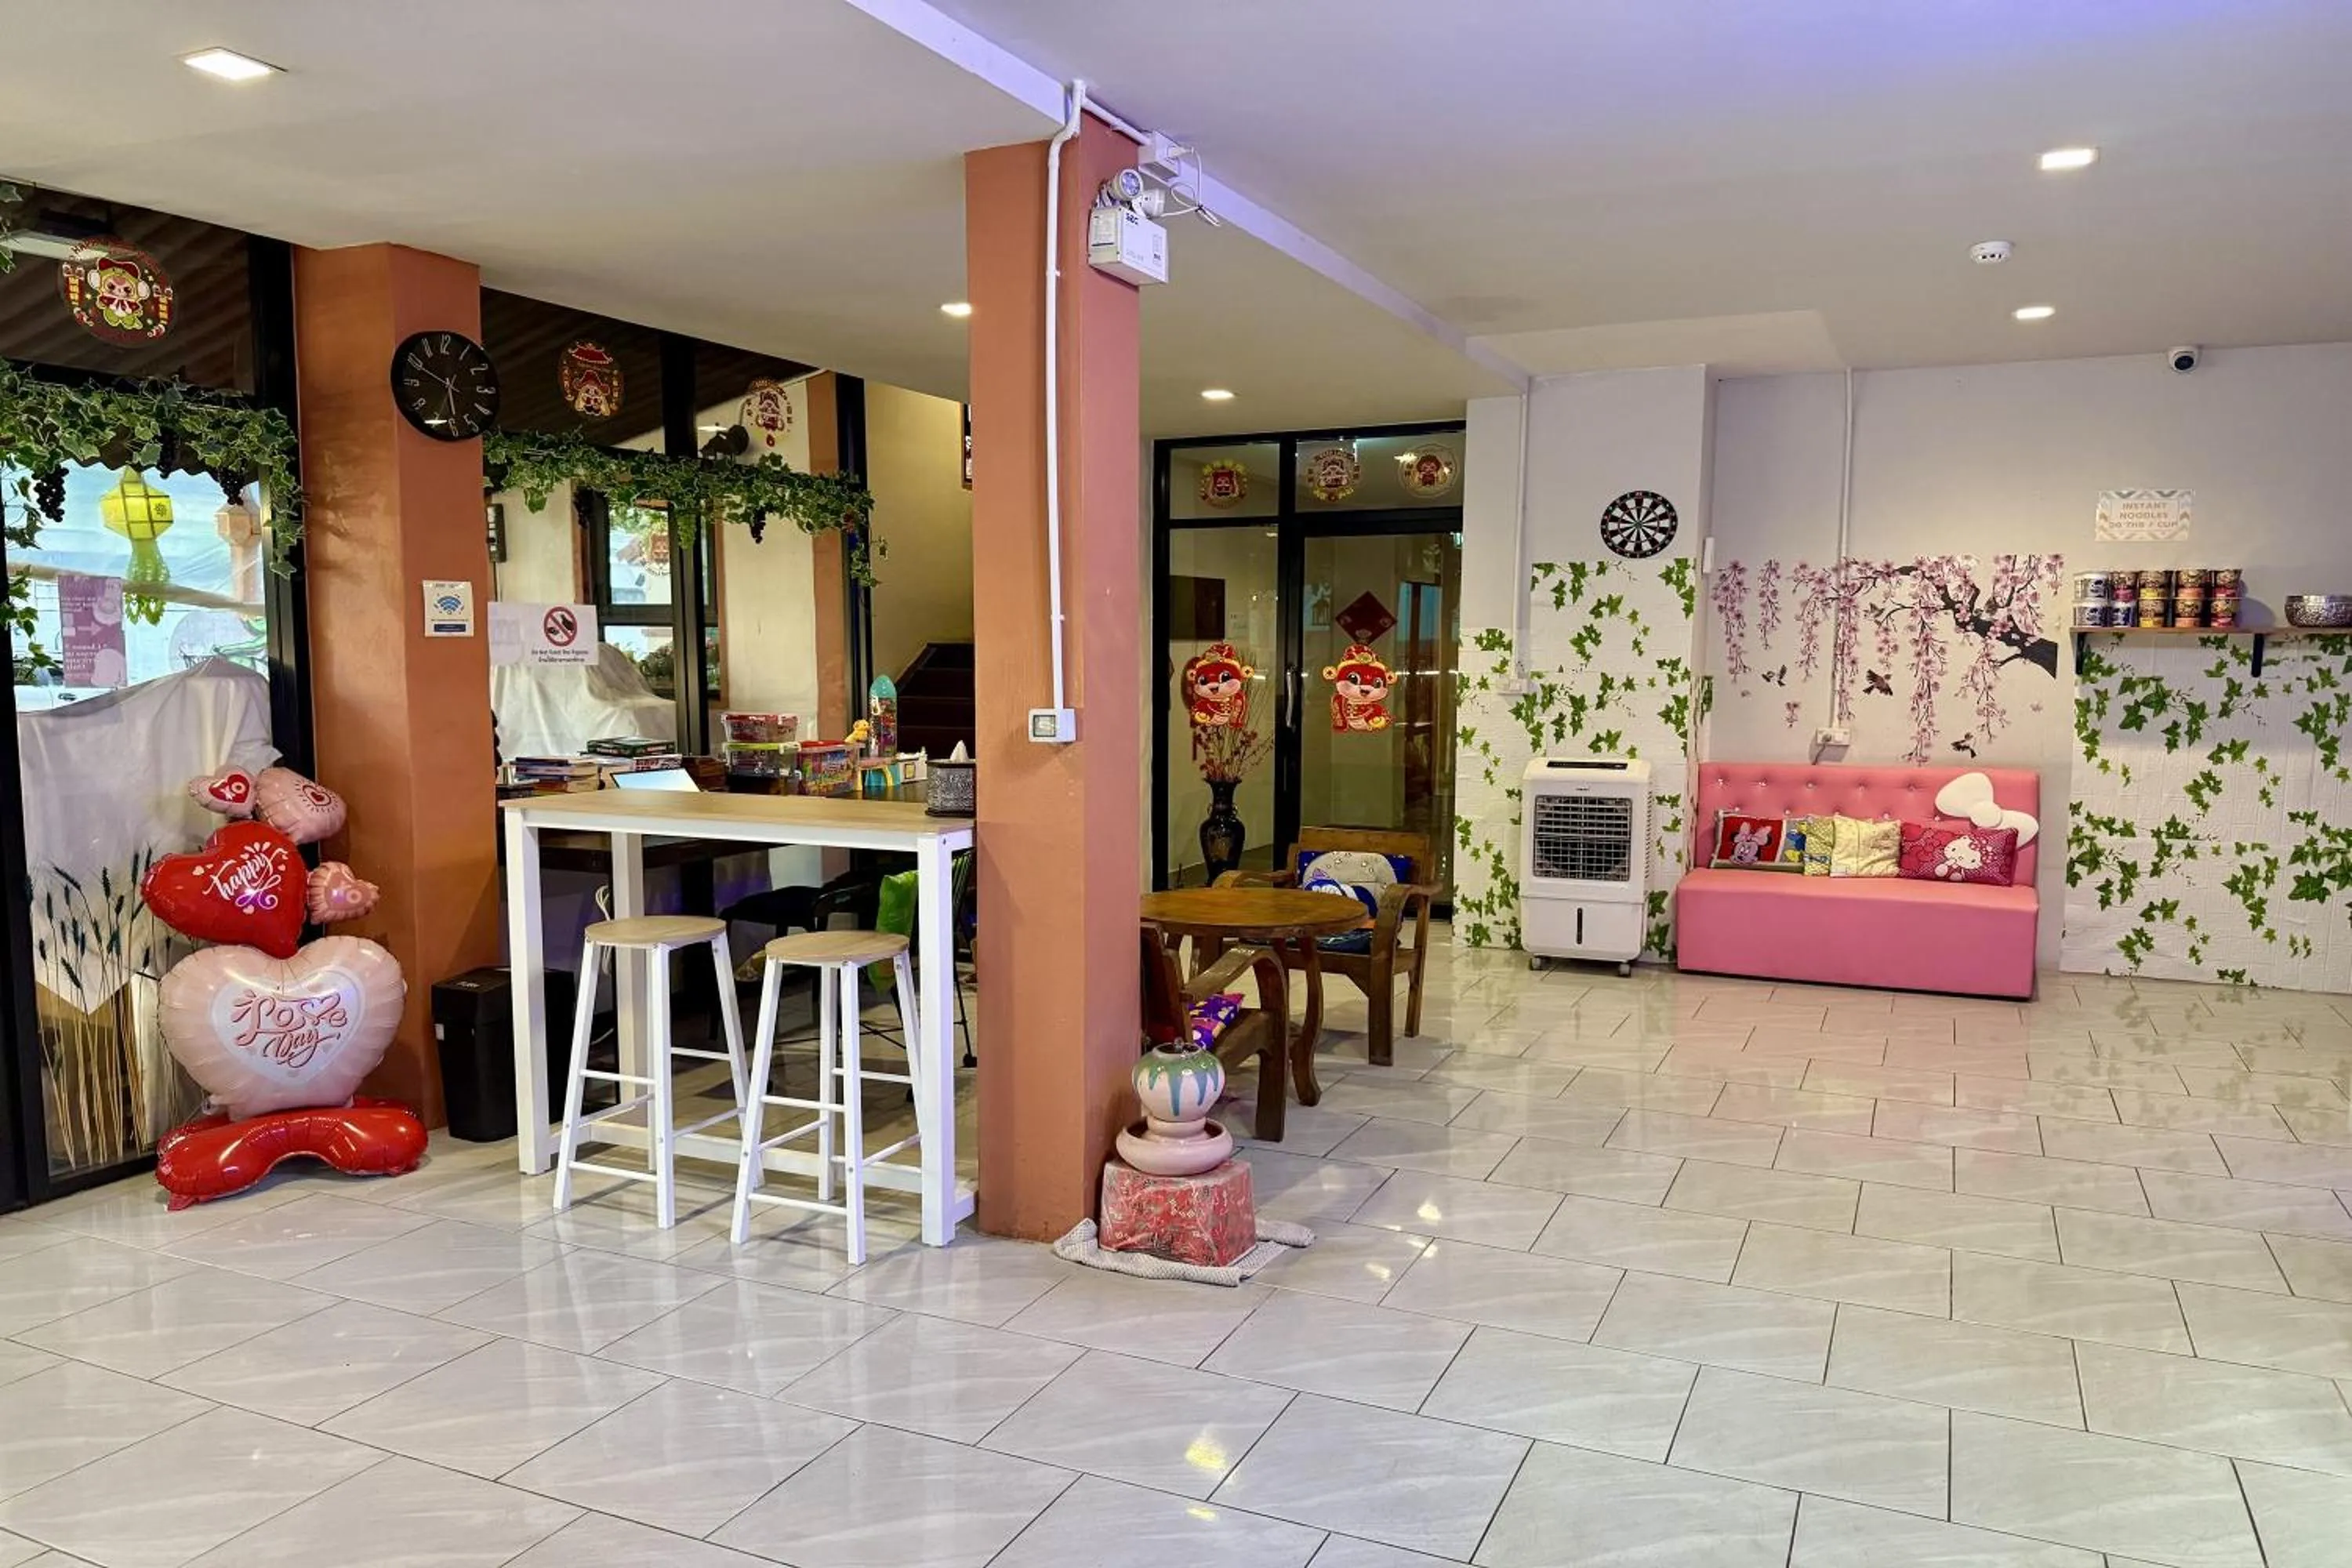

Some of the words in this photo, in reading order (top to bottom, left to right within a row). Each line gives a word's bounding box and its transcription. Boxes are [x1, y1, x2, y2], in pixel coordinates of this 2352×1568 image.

[440, 334, 451, 355] 12
[2122, 502, 2167, 510] INSTANT
[220, 782, 246, 800] XO
[202, 848, 289, 909] happy
[235, 993, 348, 1047] Love
[263, 1028, 341, 1069] Day
